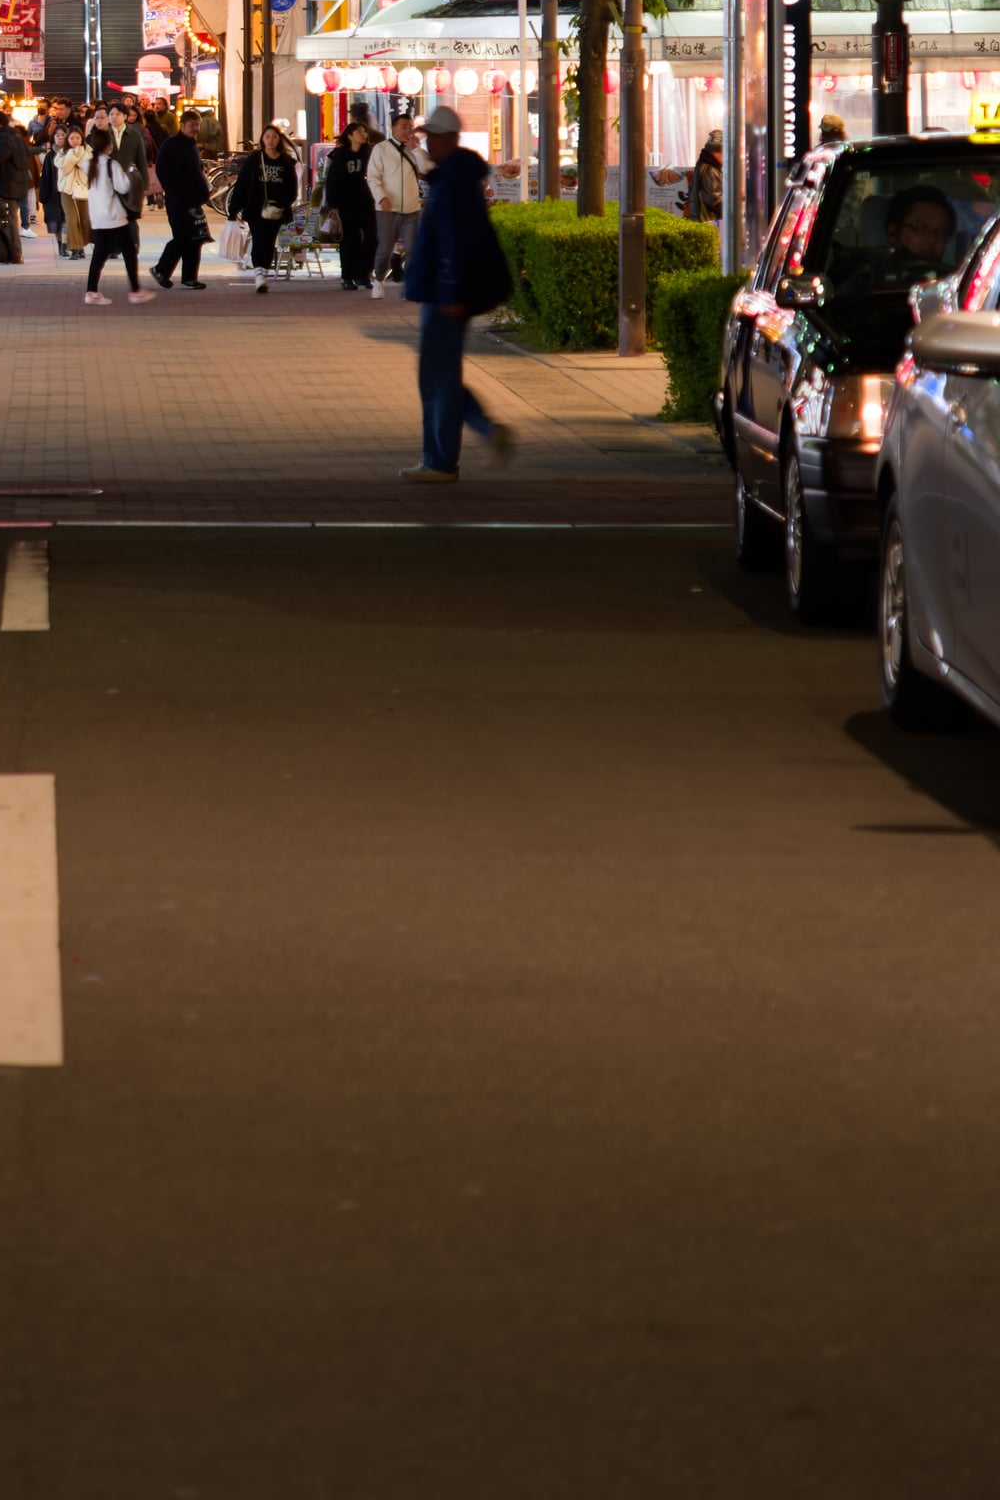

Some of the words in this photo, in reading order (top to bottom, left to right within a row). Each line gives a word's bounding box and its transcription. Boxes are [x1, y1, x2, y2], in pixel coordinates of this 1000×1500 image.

[665, 41, 706, 55] 味自慢
[783, 23, 796, 159] INFORMATION
